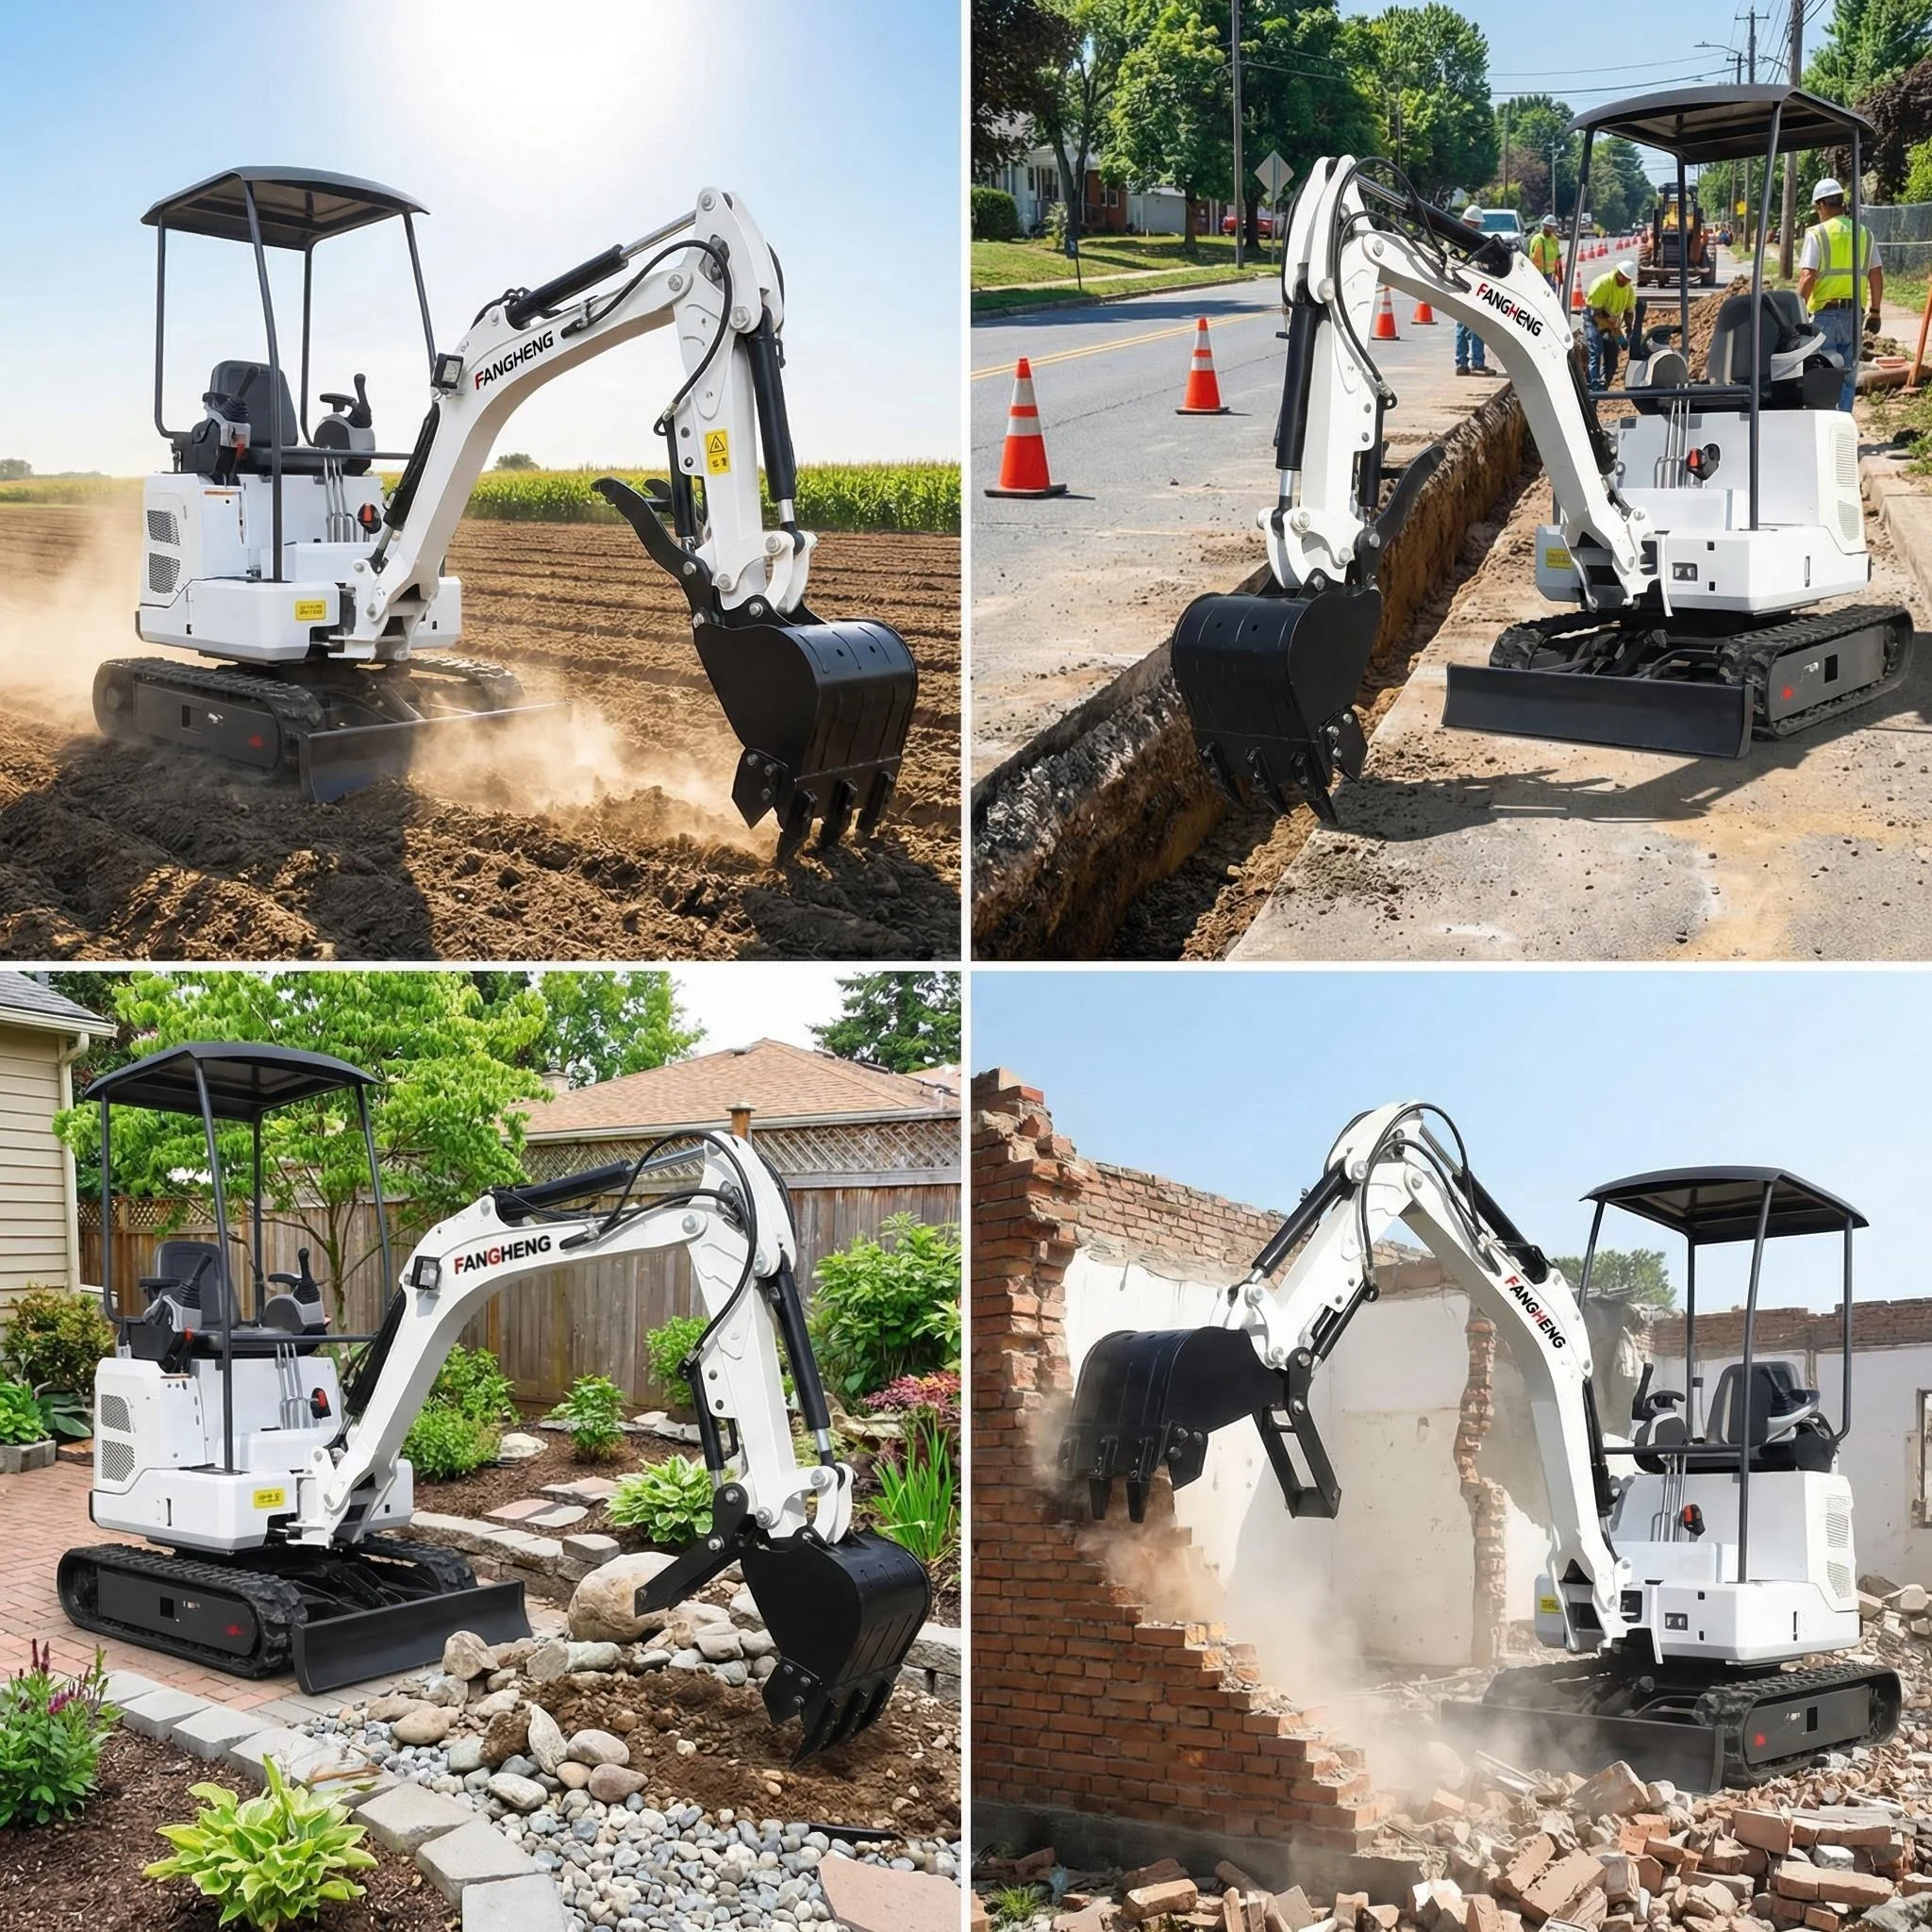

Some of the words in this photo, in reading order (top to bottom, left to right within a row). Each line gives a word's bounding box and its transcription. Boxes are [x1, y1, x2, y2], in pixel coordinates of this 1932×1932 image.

[1475, 283, 1543, 337] FANGHENG
[475, 330, 554, 391] FANGHENG
[454, 1235, 551, 1274] FANGHENG
[1505, 1275, 1566, 1348] FANGHENG
